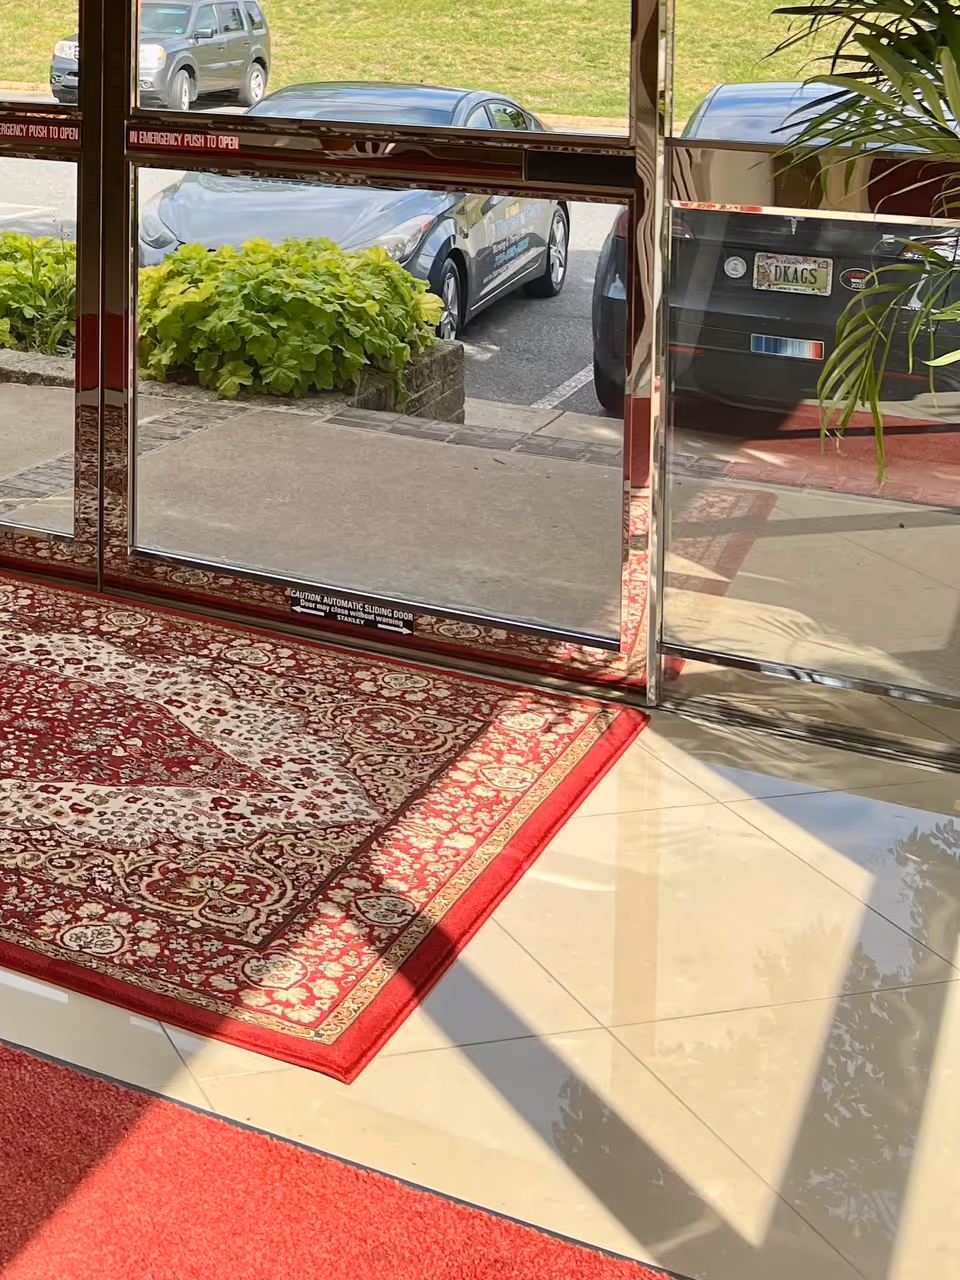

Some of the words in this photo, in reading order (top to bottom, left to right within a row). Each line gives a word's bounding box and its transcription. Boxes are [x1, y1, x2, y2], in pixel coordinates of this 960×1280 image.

[28, 124, 48, 138] PUSH
[49, 126, 59, 139] TO
[59, 126, 79, 141] OPEN
[129, 130, 138, 144] IN
[139, 131, 183, 146] EMERGENCY
[183, 133, 205, 147] PUSH
[206, 134, 217, 148] TO
[218, 135, 240, 150] OPEN
[774, 265, 818, 285] DKAGS
[291, 589, 322, 602] CAUTION:
[323, 596, 363, 611] AUTOMATIC
[364, 604, 392, 617] SLIDING
[393, 610, 414, 621] DOOR
[300, 599, 316, 608] Door
[316, 603, 330, 612] may
[331, 606, 349, 616] close
[350, 609, 375, 621] without
[375, 615, 404, 627] warning
[337, 615, 364, 625] STANLEY
